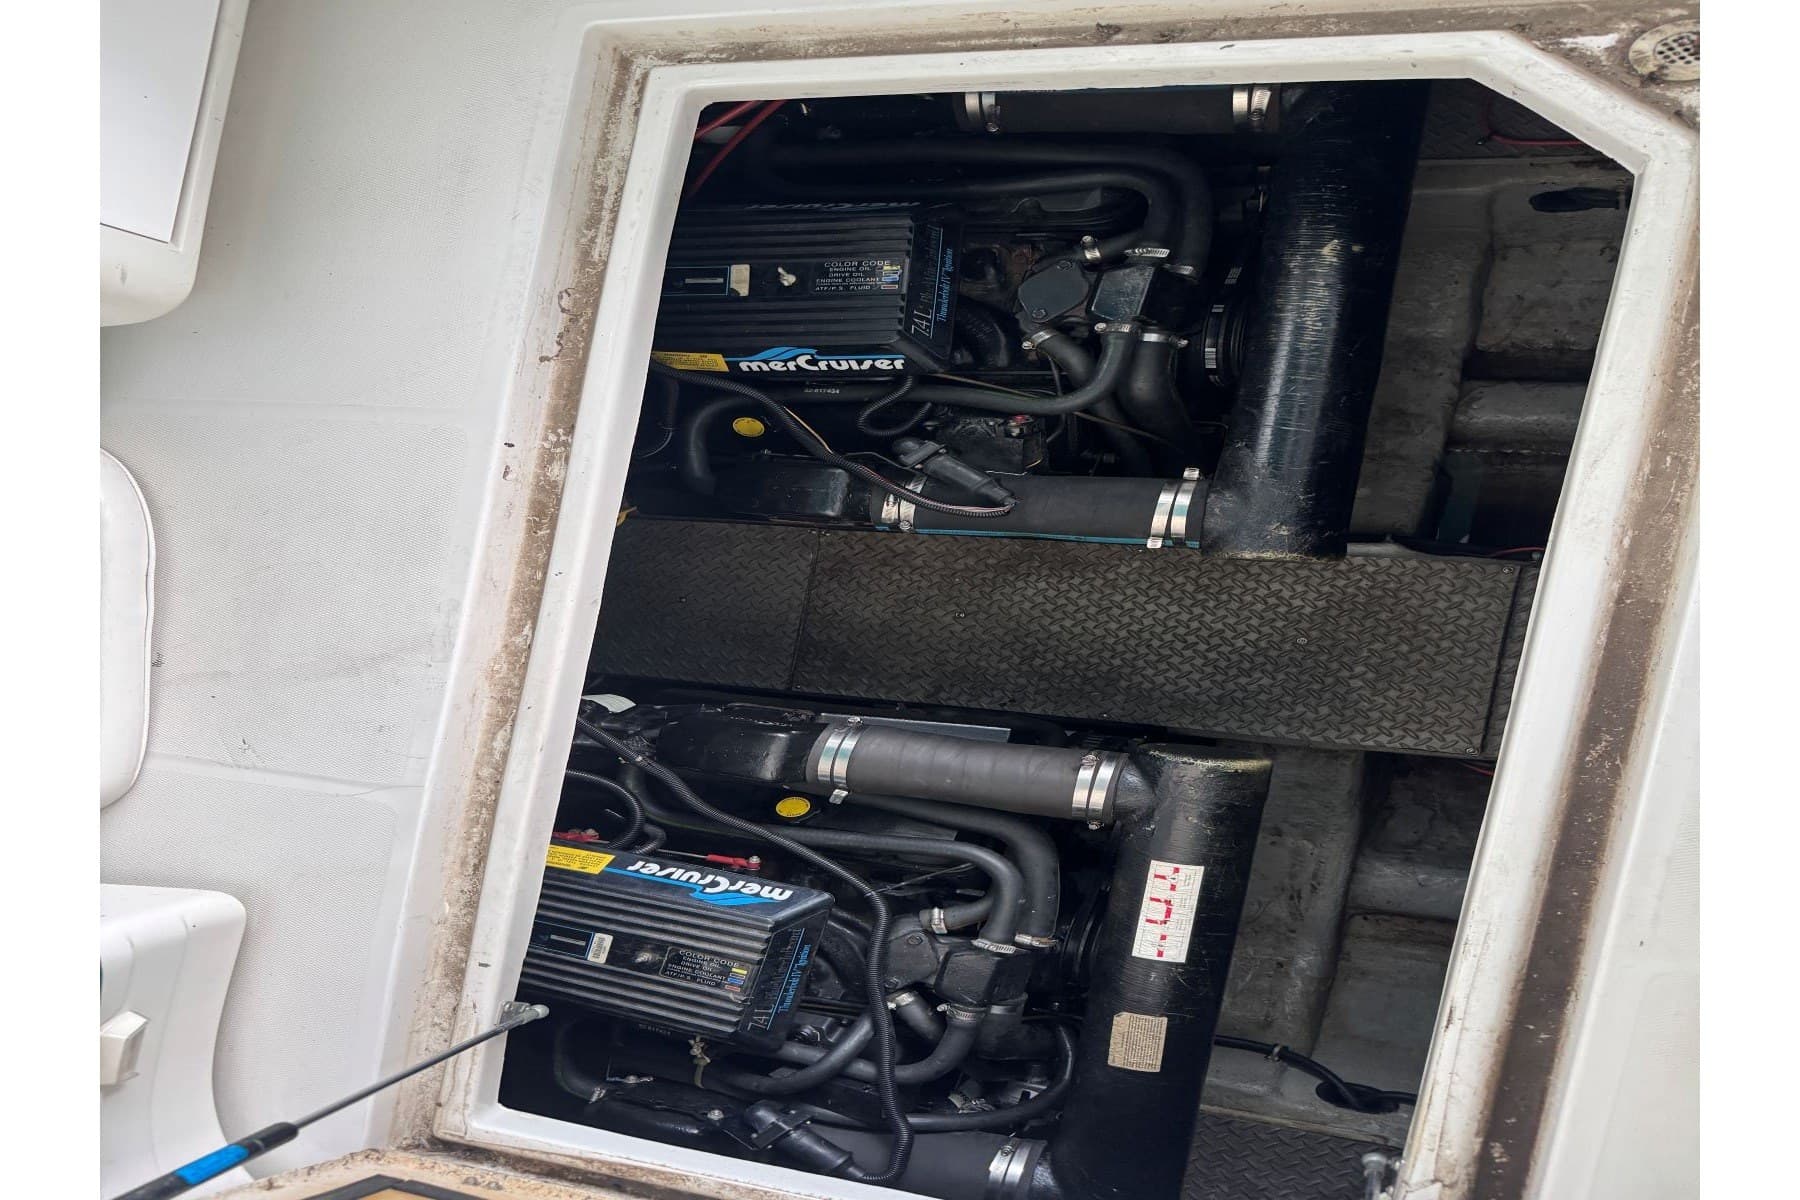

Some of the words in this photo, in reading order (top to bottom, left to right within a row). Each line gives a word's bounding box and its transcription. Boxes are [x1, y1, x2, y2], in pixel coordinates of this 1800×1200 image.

[739, 355, 905, 372] merCruiser
[627, 861, 794, 901] merCruiser
[680, 950, 711, 961] COLOR
[713, 959, 740, 967] CODE
